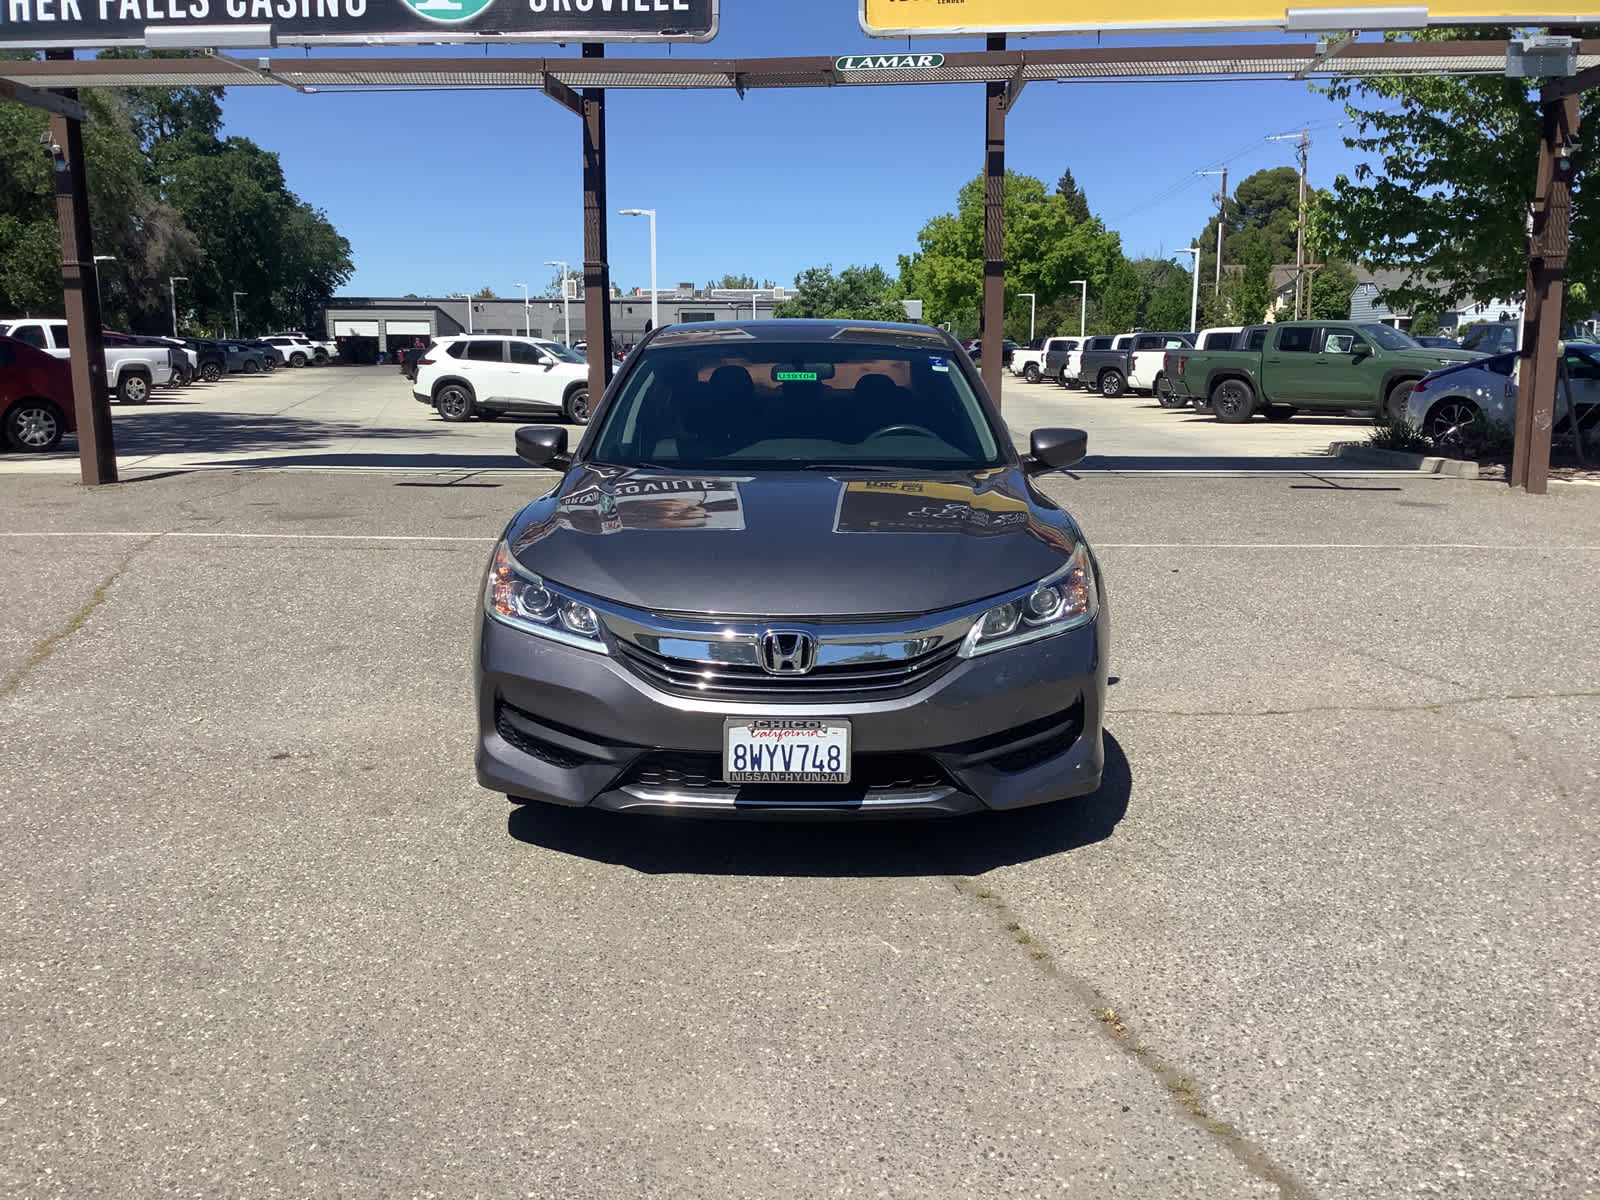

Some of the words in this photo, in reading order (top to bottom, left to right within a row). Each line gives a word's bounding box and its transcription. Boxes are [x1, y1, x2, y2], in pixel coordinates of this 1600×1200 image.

[844, 55, 934, 69] LAMAR
[755, 720, 820, 728] CHICO
[733, 743, 841, 772] 8WYV748
[731, 772, 844, 782] NISSAN-HYUNDAI
